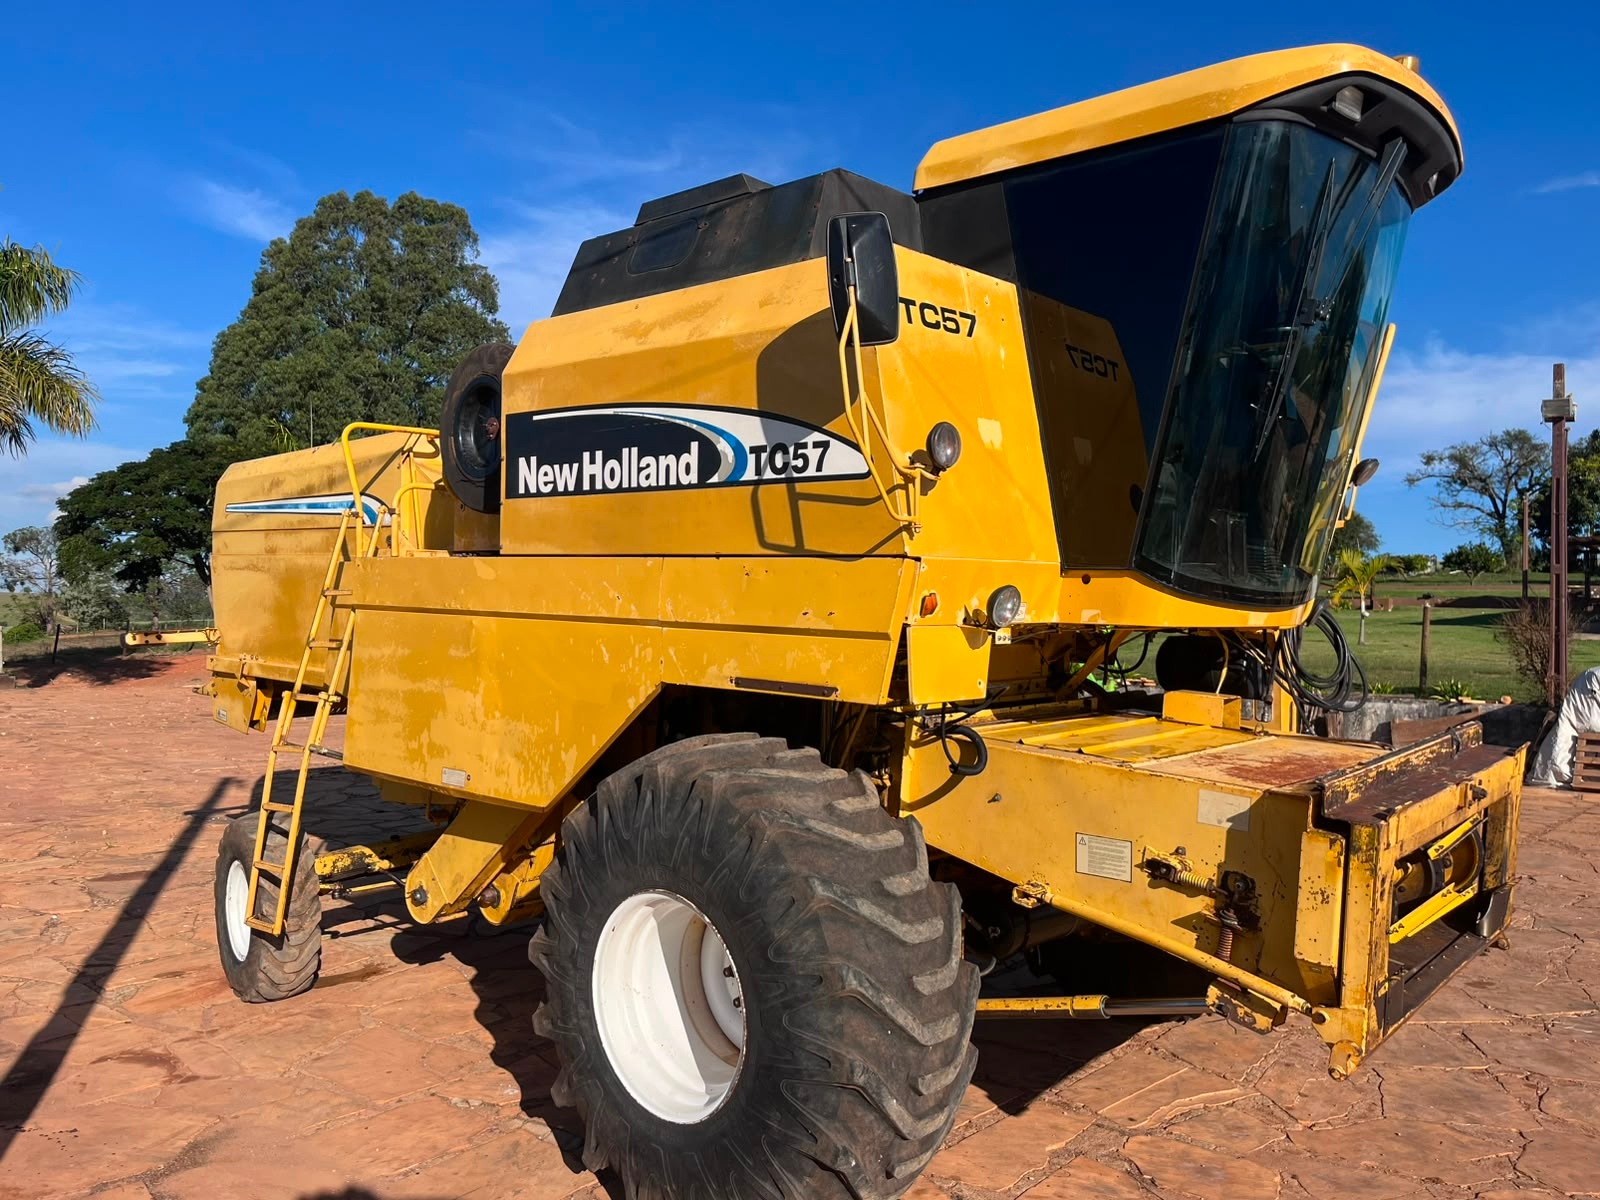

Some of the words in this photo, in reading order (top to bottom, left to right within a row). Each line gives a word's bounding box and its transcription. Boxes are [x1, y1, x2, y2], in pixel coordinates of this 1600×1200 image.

[899, 296, 977, 338] TC57
[518, 455, 580, 494] New
[582, 441, 699, 490] Holland
[749, 440, 831, 477] TC57
